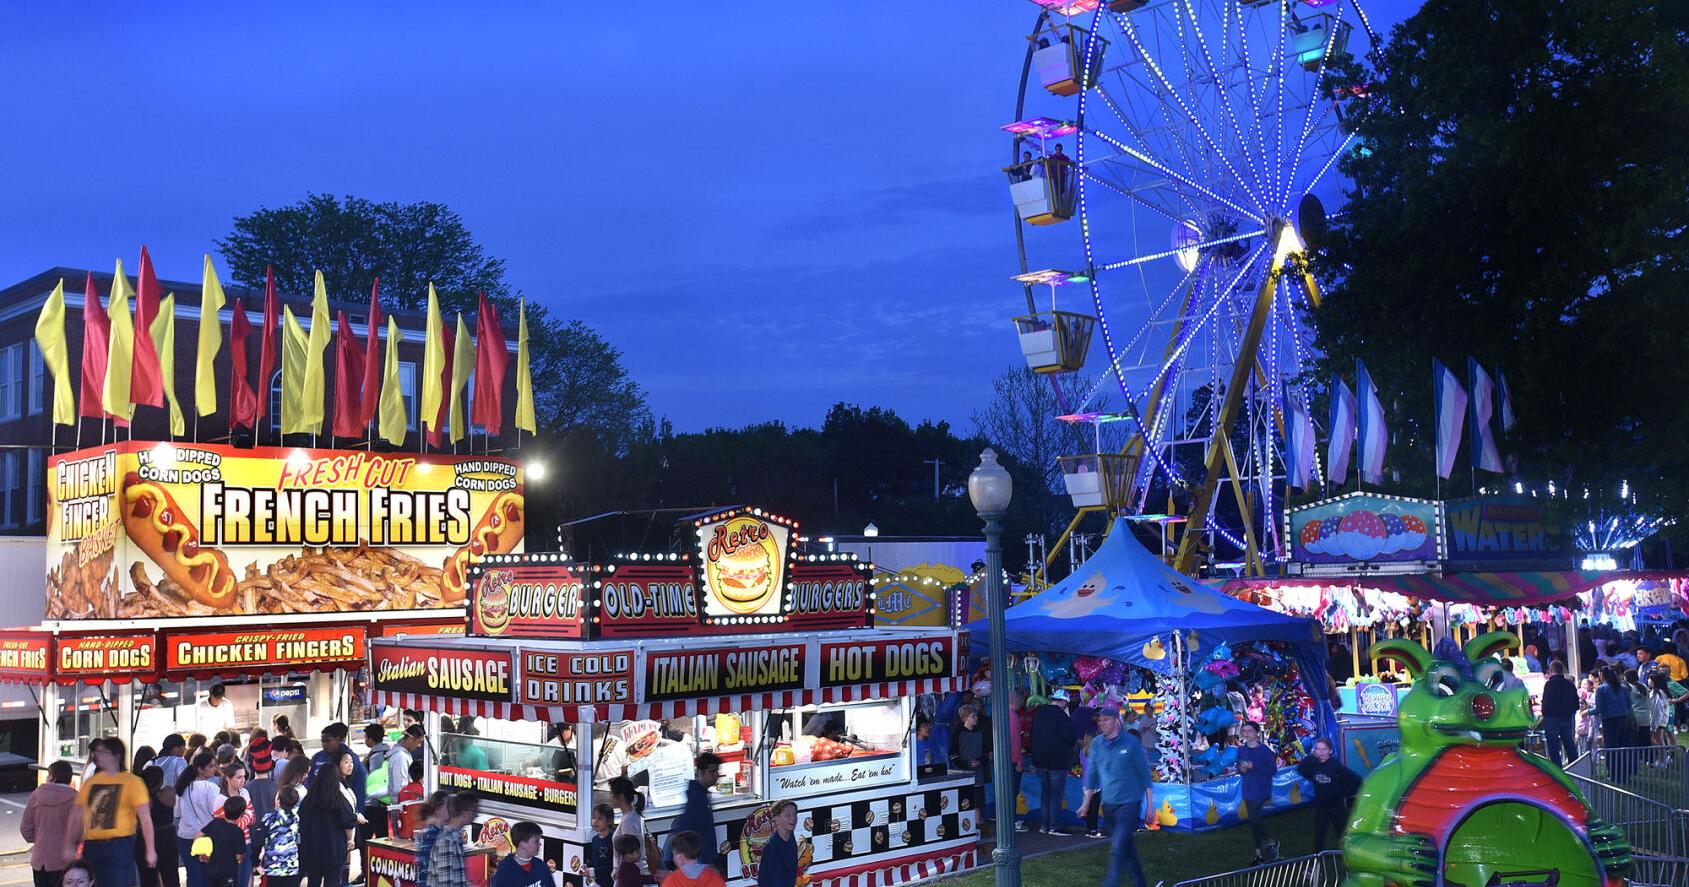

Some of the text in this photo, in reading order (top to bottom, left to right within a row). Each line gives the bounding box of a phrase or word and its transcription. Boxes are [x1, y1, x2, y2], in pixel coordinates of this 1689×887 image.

[176, 448, 221, 468] DIPPED
[277, 453, 414, 491] FRESH CUT
[454, 460, 517, 477] HAND DIPPED
[57, 450, 116, 502] CHICKEN
[138, 464, 221, 484] CORN DOGS
[455, 475, 517, 492] CORN DOGS
[61, 495, 109, 541] FINGER
[199, 482, 473, 547] FRENCH FRIES
[80, 517, 121, 567] BASKET
[708, 523, 769, 562] Retro
[481, 570, 579, 618] Retro BURGER
[603, 583, 697, 618] OLD-TIME
[790, 580, 864, 614] BURGERS
[79, 640, 134, 649] HAND-DIPPED
[234, 633, 305, 643] CRISPY-FRIED
[437, 626, 466, 635] FRES
[0, 646, 46, 669] NCH FRIES
[61, 644, 150, 669] CORN DOGS
[177, 635, 354, 665] CHICKEN FINGERS
[526, 653, 629, 675] ICE COLD
[828, 645, 877, 682] HOT
[885, 641, 945, 677] DOGS
[377, 655, 509, 694] Italian SAUSAGE
[652, 647, 799, 694] ITALIAN SAUSAGE
[280, 689, 300, 698] pepsi
[526, 678, 629, 703] DRINKS
[439, 771, 577, 806] HOT DOGS ITALIAN SAUSAGE BURGERS
[370, 855, 417, 882] CONDIMEN
